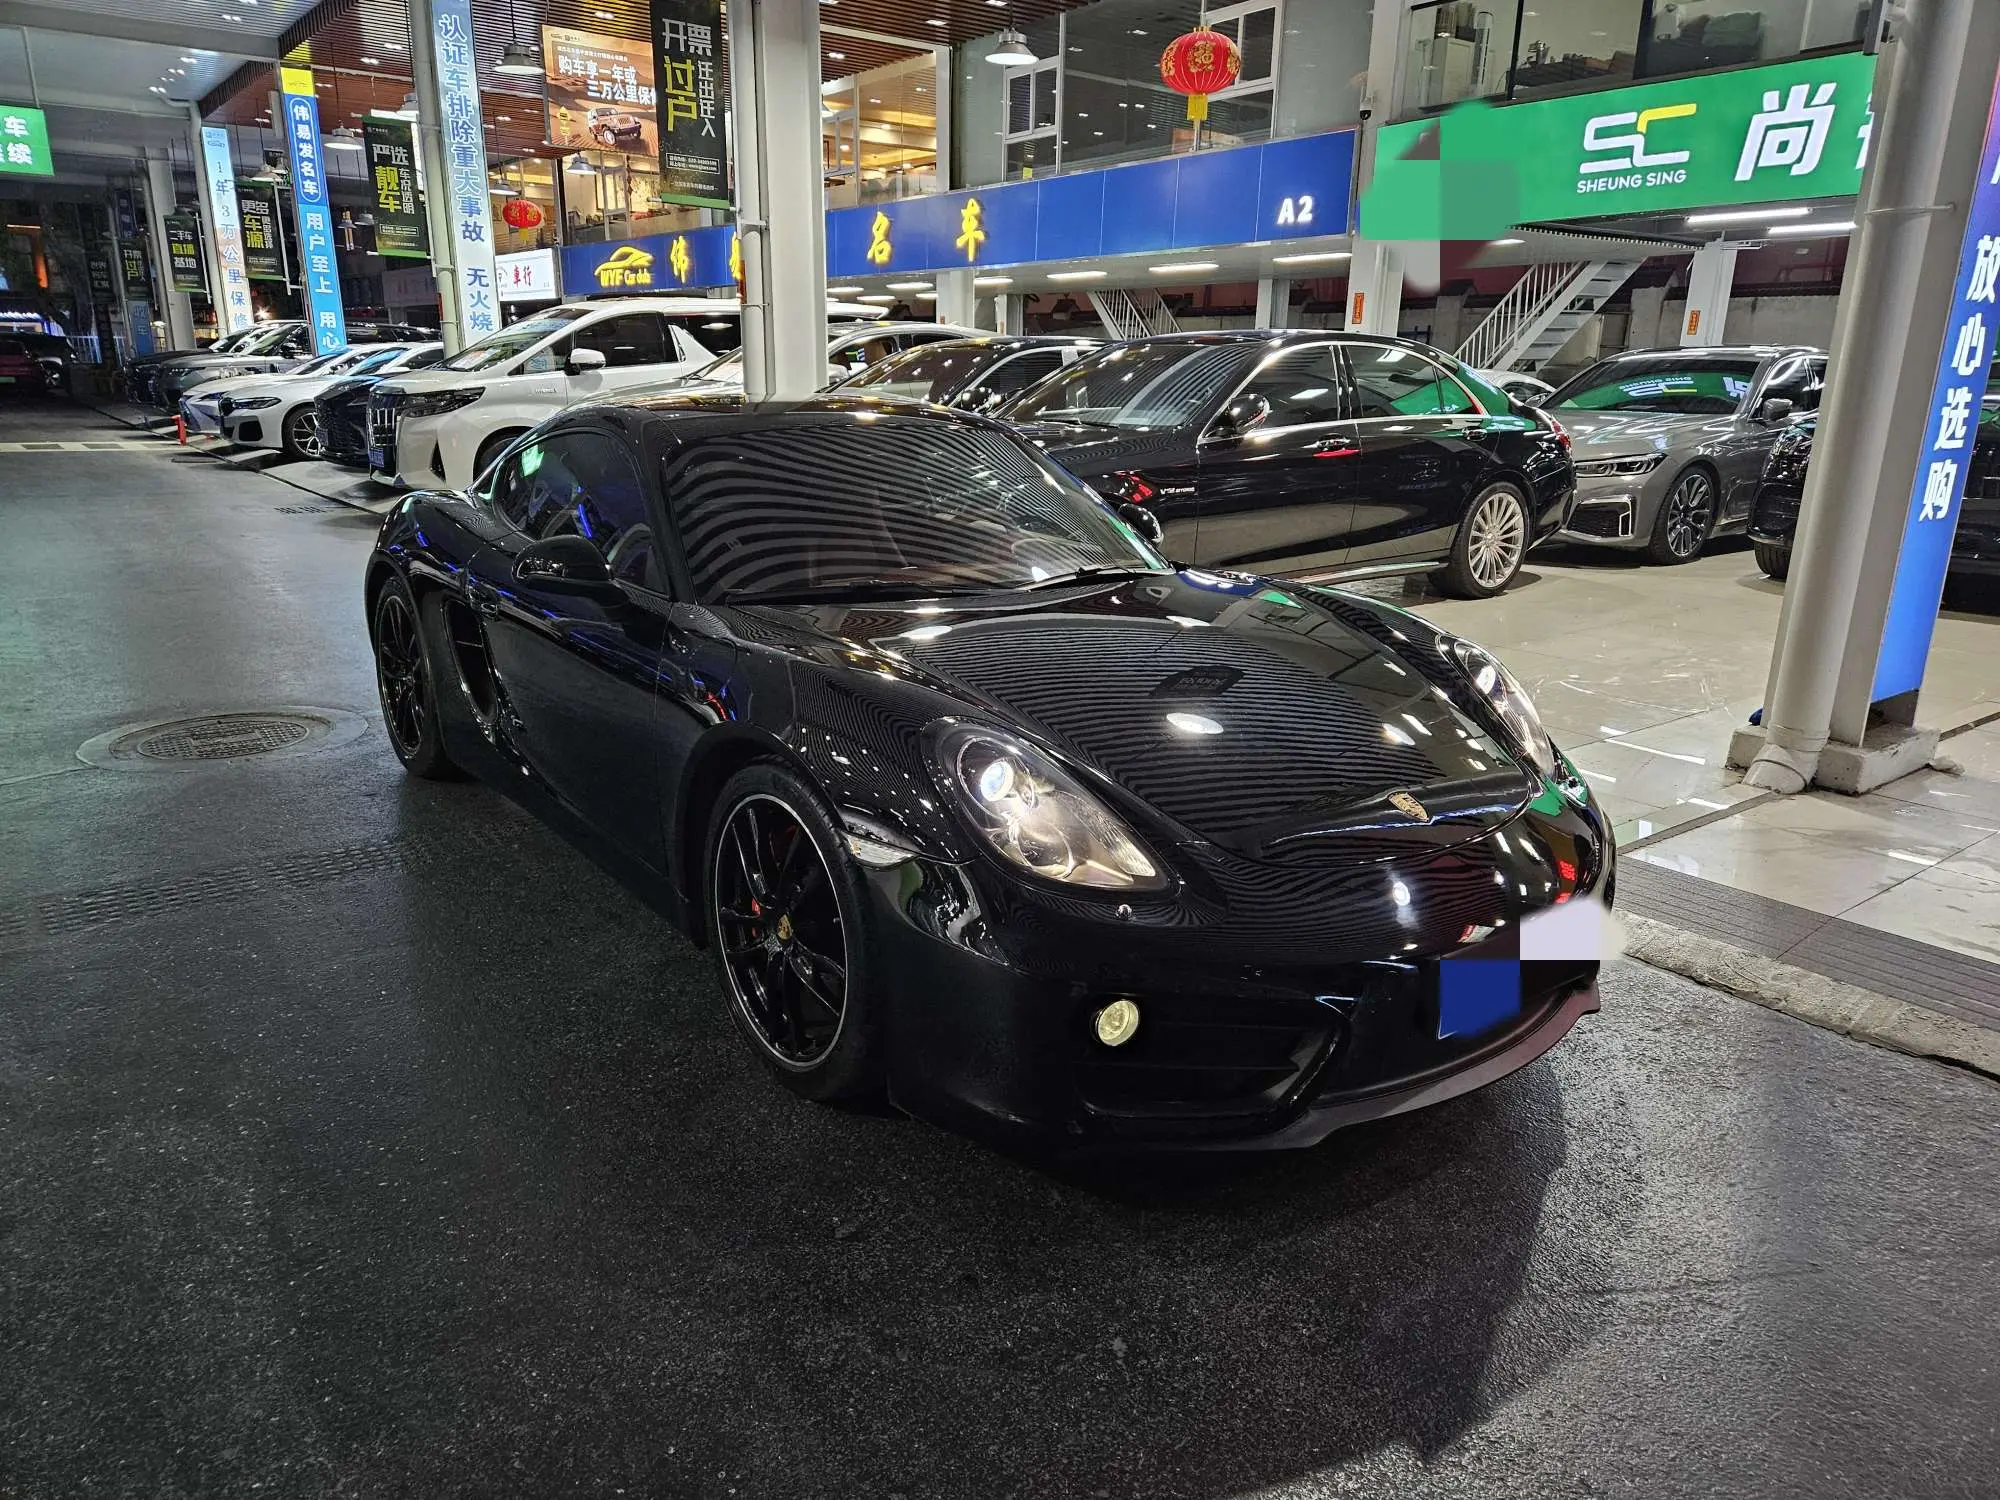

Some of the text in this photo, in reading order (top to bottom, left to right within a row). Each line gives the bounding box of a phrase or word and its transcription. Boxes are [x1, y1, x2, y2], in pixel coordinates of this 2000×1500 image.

[662, 18, 712, 57] 开票
[558, 54, 636, 81] 购车享一年或
[664, 55, 697, 132] 过户
[0, 115, 30, 138] 车
[1734, 82, 1873, 182] 尚
[372, 143, 409, 166] 严选
[375, 165, 402, 213] 靓车
[439, 14, 494, 332] 认证车排除重大事故 无火烧
[1576, 169, 1687, 194] SHEUNG SING
[241, 199, 270, 217] 更多
[293, 104, 319, 196] 伟易发名车
[306, 212, 334, 294] 用户至上
[398, 168, 415, 215] 车况透明
[1277, 195, 1313, 225] A2
[169, 230, 193, 241] 二手车
[214, 160, 249, 329] 1年3万公里保修
[243, 214, 264, 249] 车源
[174, 256, 197, 268] 基地
[600, 269, 623, 287] WYF
[1919, 234, 2000, 522] 放心选购
